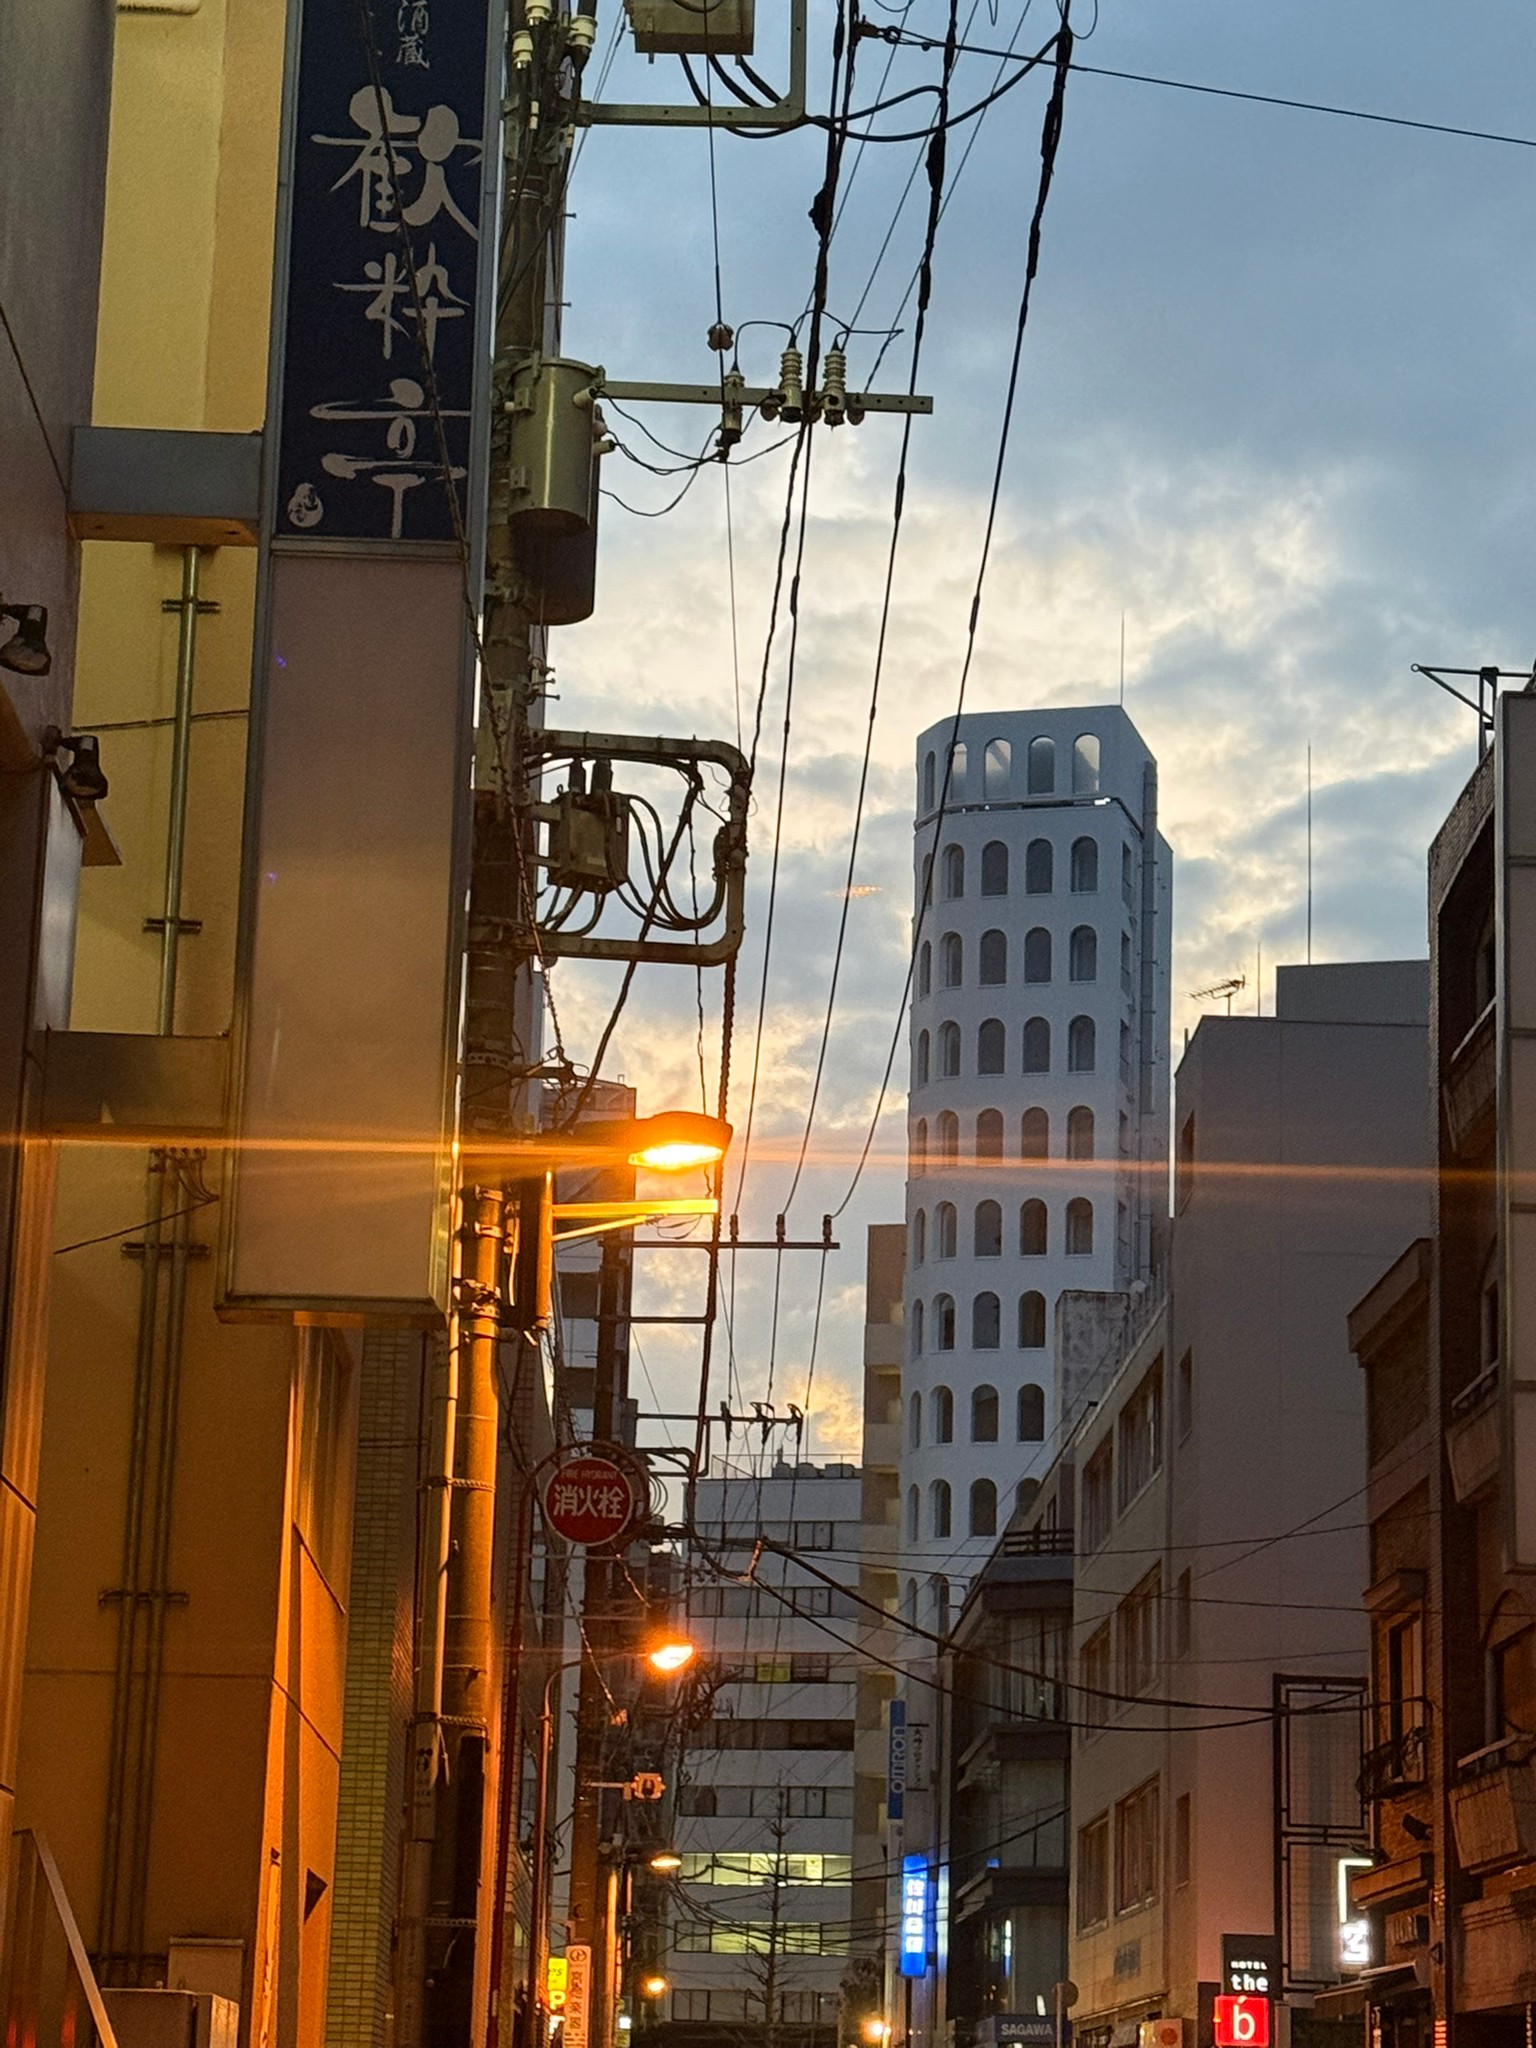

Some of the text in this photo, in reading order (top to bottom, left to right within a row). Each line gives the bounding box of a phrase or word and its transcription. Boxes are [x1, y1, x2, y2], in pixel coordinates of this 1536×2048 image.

[395, 0, 430, 69] 酒蔵
[553, 1483, 625, 1519] 消火栓
[1230, 1960, 1268, 1970] HOTEL
[1230, 1973, 1269, 1992] the
[1001, 2023, 1053, 2036] SAGAWA
